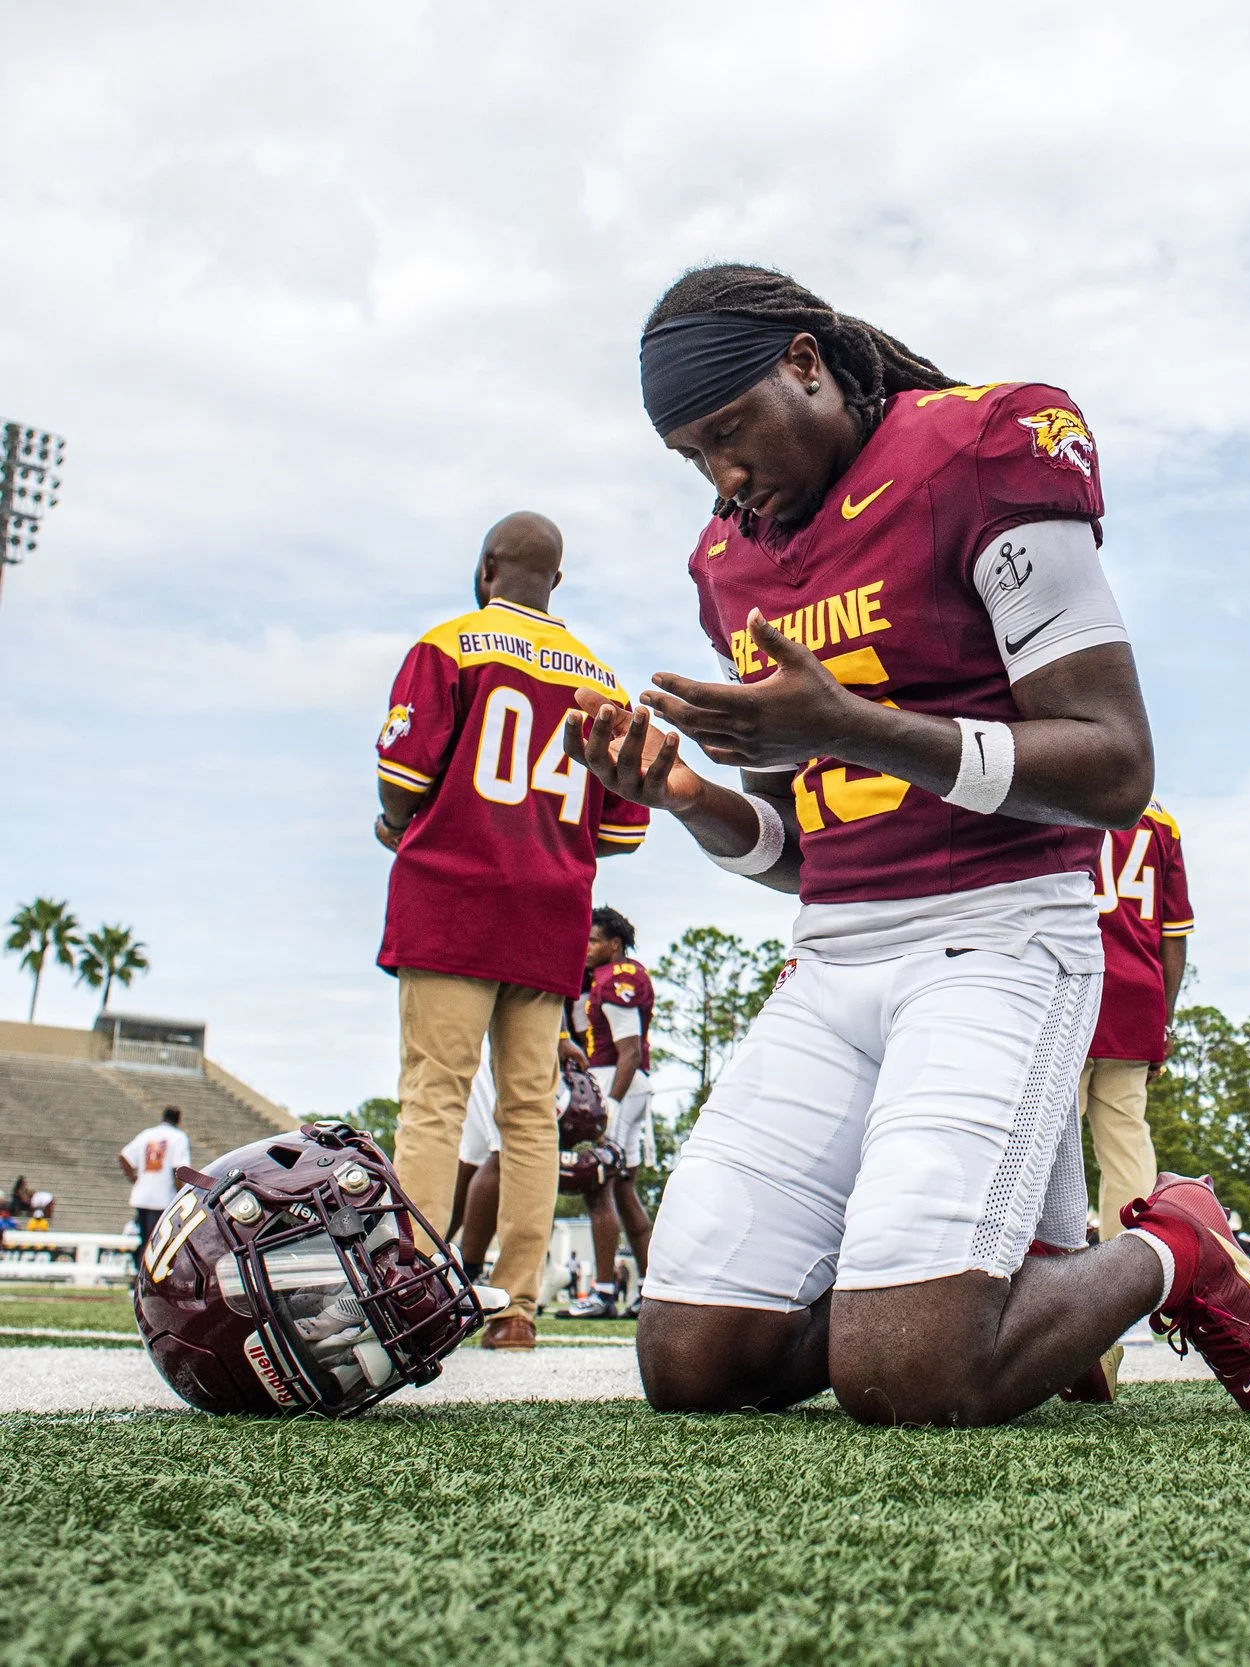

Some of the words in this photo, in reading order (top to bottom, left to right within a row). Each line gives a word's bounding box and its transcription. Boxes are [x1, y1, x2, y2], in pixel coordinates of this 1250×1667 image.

[458, 633, 617, 690] BETHUNE-COOKMAN
[473, 686, 588, 825] 04
[144, 1191, 208, 1284] 15
[248, 1345, 293, 1404] Riddell
